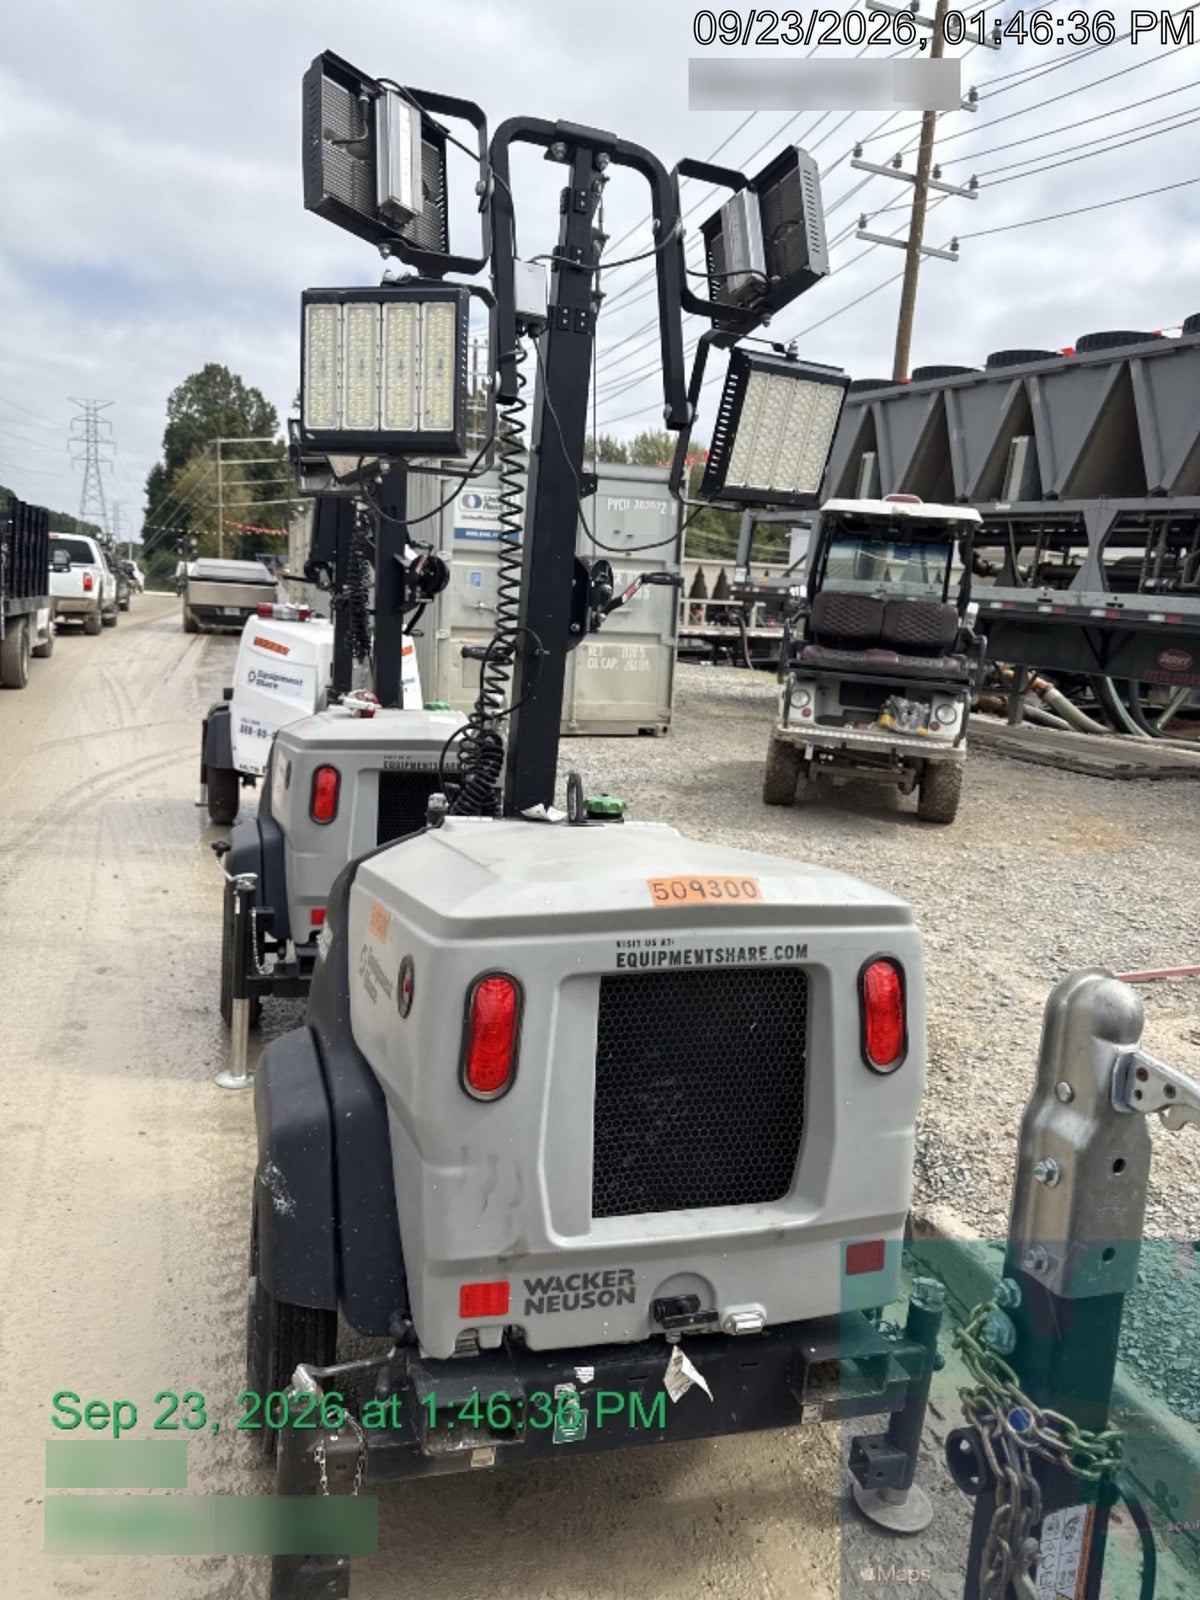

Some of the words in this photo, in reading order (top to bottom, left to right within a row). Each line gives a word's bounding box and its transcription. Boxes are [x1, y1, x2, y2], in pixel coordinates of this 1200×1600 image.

[652, 879, 758, 901] 509300
[616, 939, 641, 949] VISIT
[645, 938, 657, 947] US
[616, 944, 808, 968] EQUIPMENTSHARE.COM
[523, 1268, 635, 1297] WACKER
[524, 1286, 636, 1317] NEUSON
